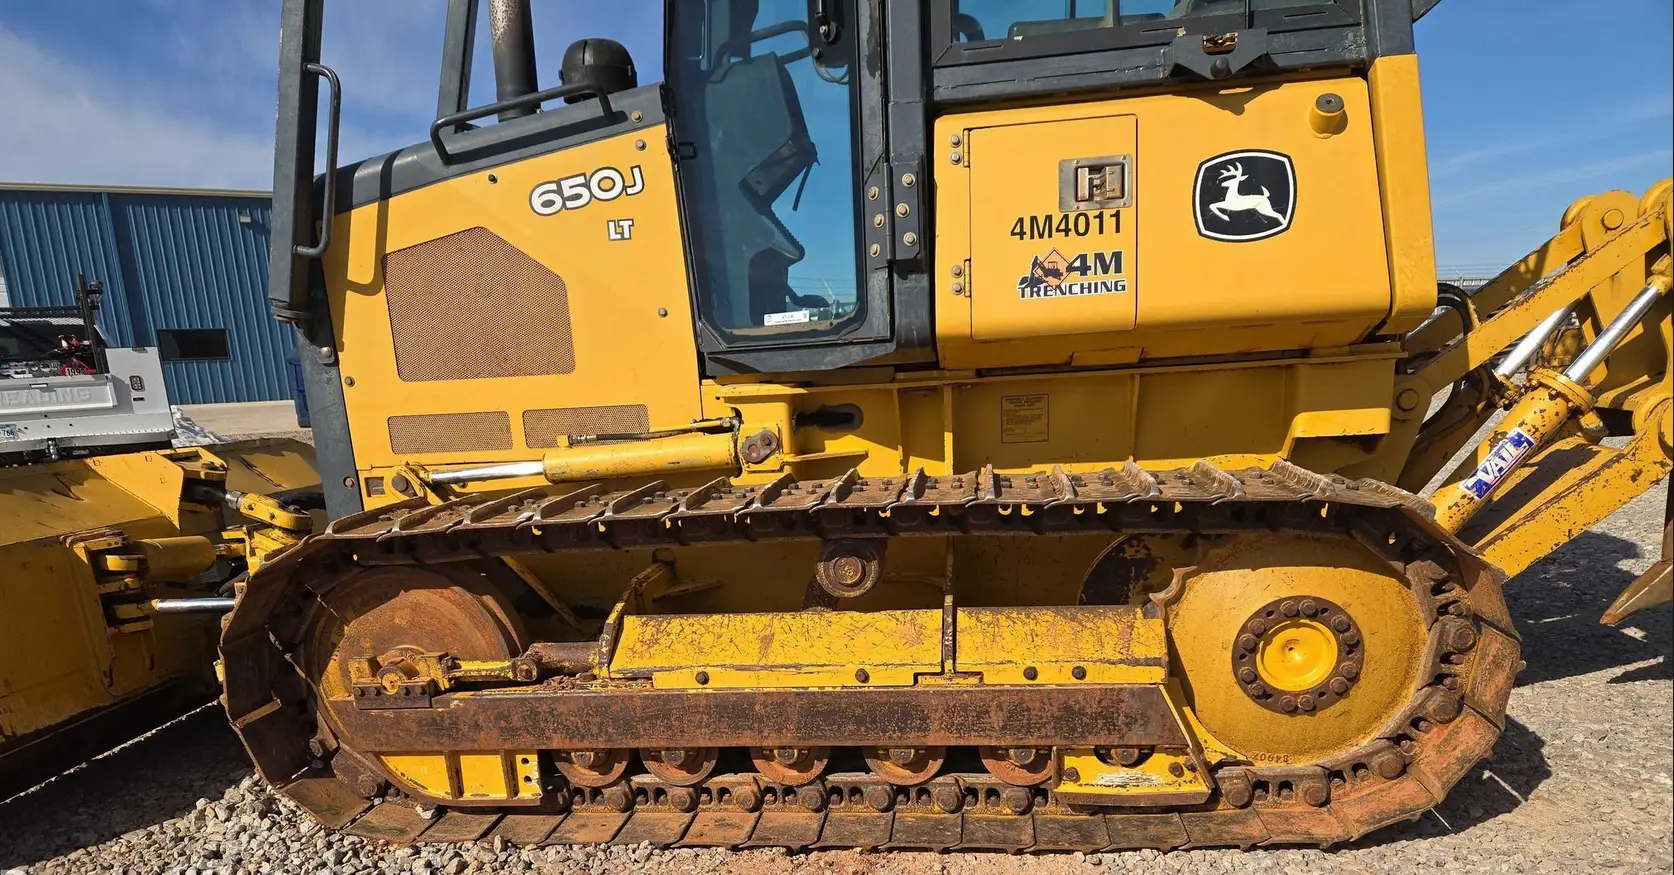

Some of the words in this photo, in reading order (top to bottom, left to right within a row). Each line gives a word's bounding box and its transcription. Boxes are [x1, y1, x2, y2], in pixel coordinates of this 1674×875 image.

[529, 165, 644, 216] 650J
[607, 219, 634, 240] LT
[1010, 210, 1121, 240] 4M4011
[1066, 251, 1122, 276] 4M
[1018, 280, 1126, 298] TRENCHING
[0, 387, 92, 406] EADING
